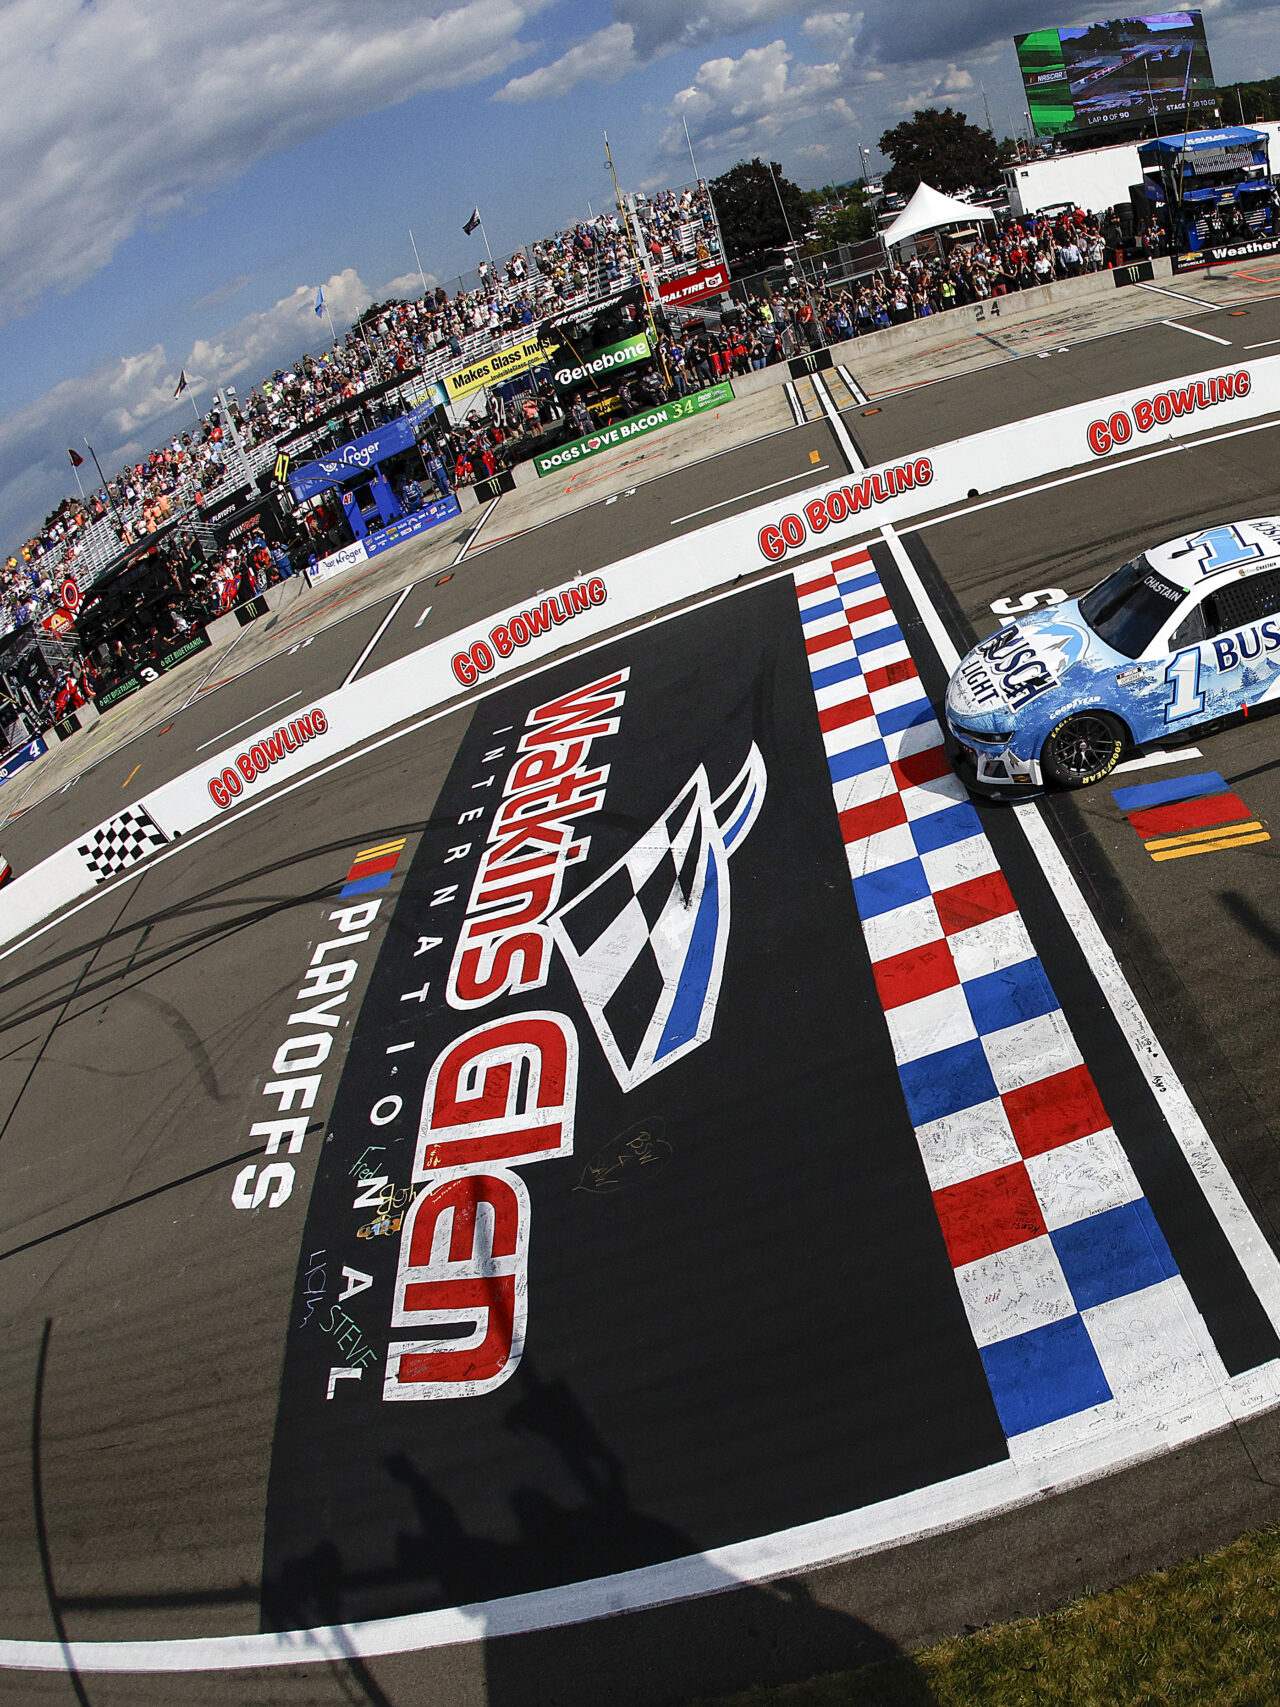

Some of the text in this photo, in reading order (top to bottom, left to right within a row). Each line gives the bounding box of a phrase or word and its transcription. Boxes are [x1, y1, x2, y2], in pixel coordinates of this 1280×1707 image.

[1037, 71, 1063, 82] NASCAR
[1088, 115, 1102, 125] LAP
[1109, 113, 1119, 121] OF
[1119, 111, 1130, 119] 90
[1166, 103, 1186, 111] STAGE
[659, 282, 705, 305] RAL TIRE
[452, 366, 490, 390] Makes
[490, 350, 522, 371] Glass
[554, 341, 648, 386] Benebone
[540, 446, 580, 472] DOGS
[620, 410, 668, 438] BACON
[673, 398, 695, 418] 34
[1087, 369, 1252, 456] GO BOWLING
[274, 452, 290, 483] 47
[339, 440, 380, 468] Kroger
[758, 457, 933, 561] GO BOWLING
[336, 547, 362, 566] Kroger
[1186, 524, 1265, 576] 1
[1143, 575, 1183, 603] CHASTAIN
[452, 577, 608, 687] GO BOWLING
[140, 666, 159, 682] 3
[961, 660, 1000, 706] LIGHT
[972, 624, 1061, 714] BUSCH
[1164, 645, 1206, 726] 1
[1049, 695, 1102, 720] GOODYEAR
[1050, 715, 1074, 740] EAGLE
[28, 741, 41, 759] 4
[208, 708, 328, 809] GO BOWLING
[1082, 740, 1122, 785] GOODYEAR
[446, 666, 631, 1011] Watkins
[231, 898, 383, 1211] PLAYOFFS
[382, 1010, 580, 1402] Glen
[318, 1304, 378, 1370] STEVE
